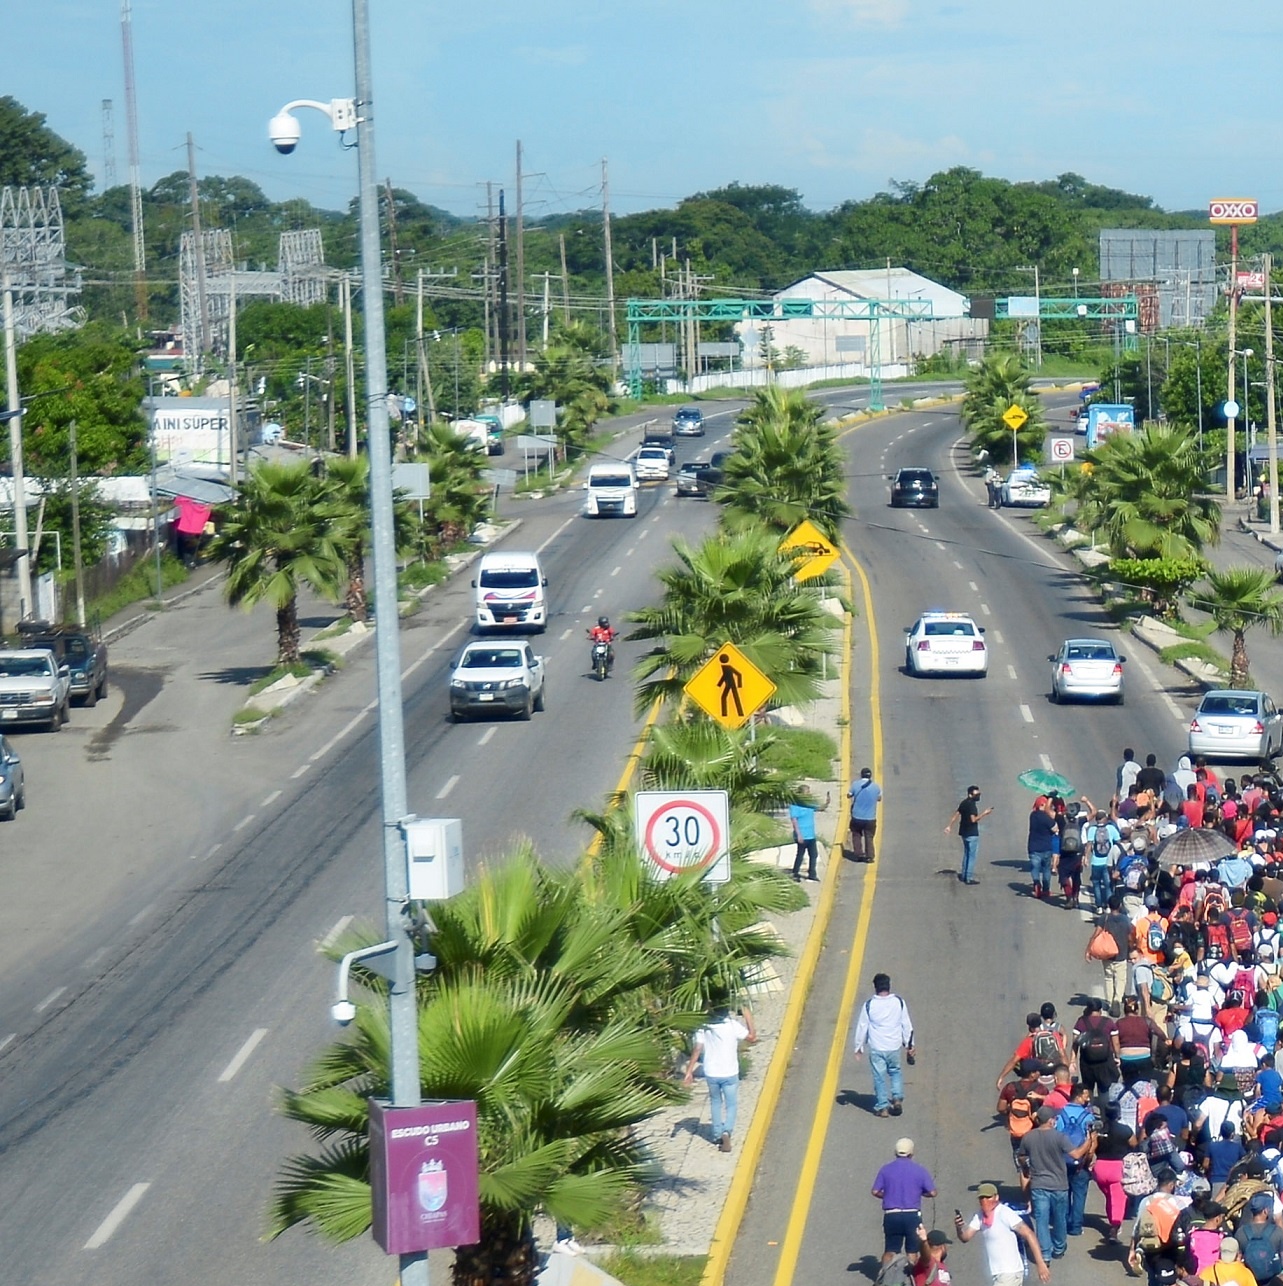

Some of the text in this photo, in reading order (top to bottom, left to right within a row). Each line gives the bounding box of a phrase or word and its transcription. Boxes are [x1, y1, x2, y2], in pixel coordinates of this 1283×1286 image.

[1210, 203, 1256, 217] OXXO
[665, 815, 700, 847] 30
[391, 1120, 470, 1138] ESCUDO URBANO
